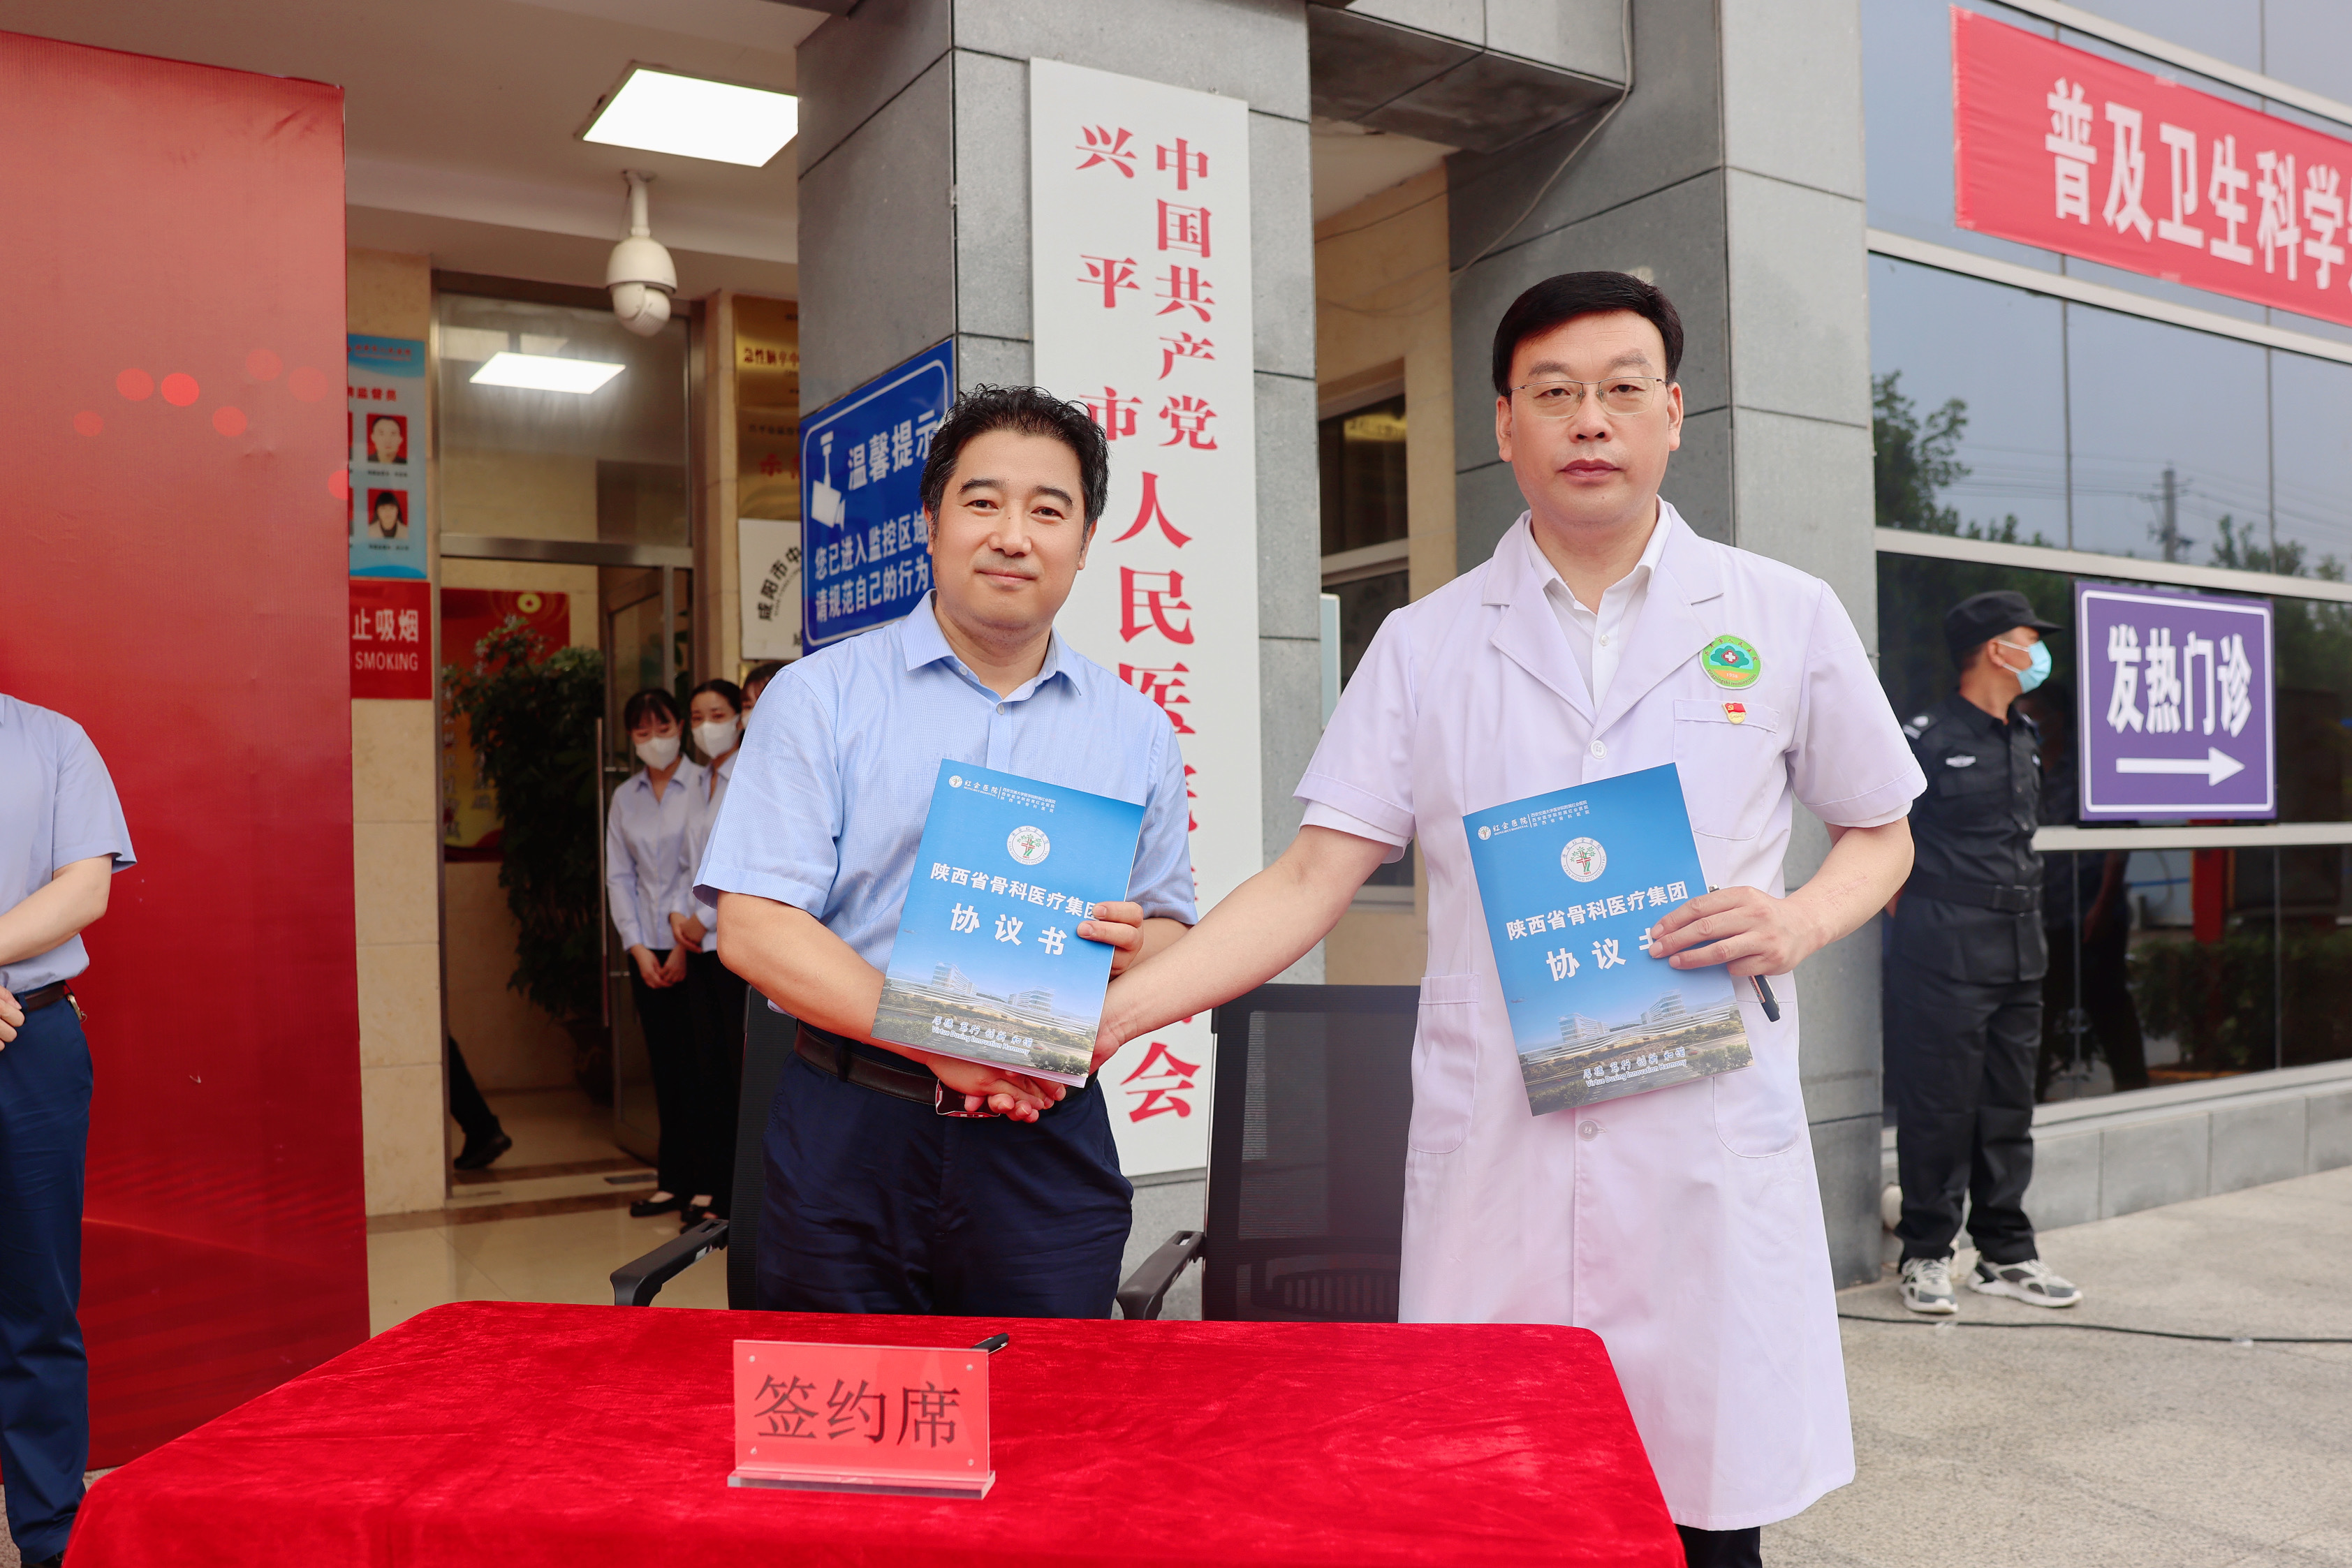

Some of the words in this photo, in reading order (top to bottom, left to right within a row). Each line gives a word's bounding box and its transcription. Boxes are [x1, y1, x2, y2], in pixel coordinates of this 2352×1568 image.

[2045, 77, 2352, 296] 普及卫生科学
[1075, 124, 1143, 442] 兴平市
[1156, 136, 1218, 451] 中国共产党
[848, 409, 937, 491] 温馨提示
[815, 508, 929, 581] 您已进入监控区域
[352, 607, 418, 643] 止吸烟
[355, 651, 418, 671] SMOKING
[2106, 623, 2253, 738] 发热门诊
[964, 780, 999, 794] 红会医院
[1112, 471, 1201, 1124] 人民医会
[1492, 816, 1528, 832] 红会医院
[949, 902, 1068, 956] 协议书
[1506, 881, 1689, 940] 陕西省骨科医疗集团
[932, 1025, 950, 1036] Virtue
[971, 1035, 1002, 1049] Innovation
[1002, 1042, 1030, 1056] Harmony
[1585, 1077, 1605, 1088] Virtue
[1626, 1065, 1659, 1079] Innovation
[1659, 1059, 1686, 1071] Harmony
[754, 1375, 961, 1448] 签约席
